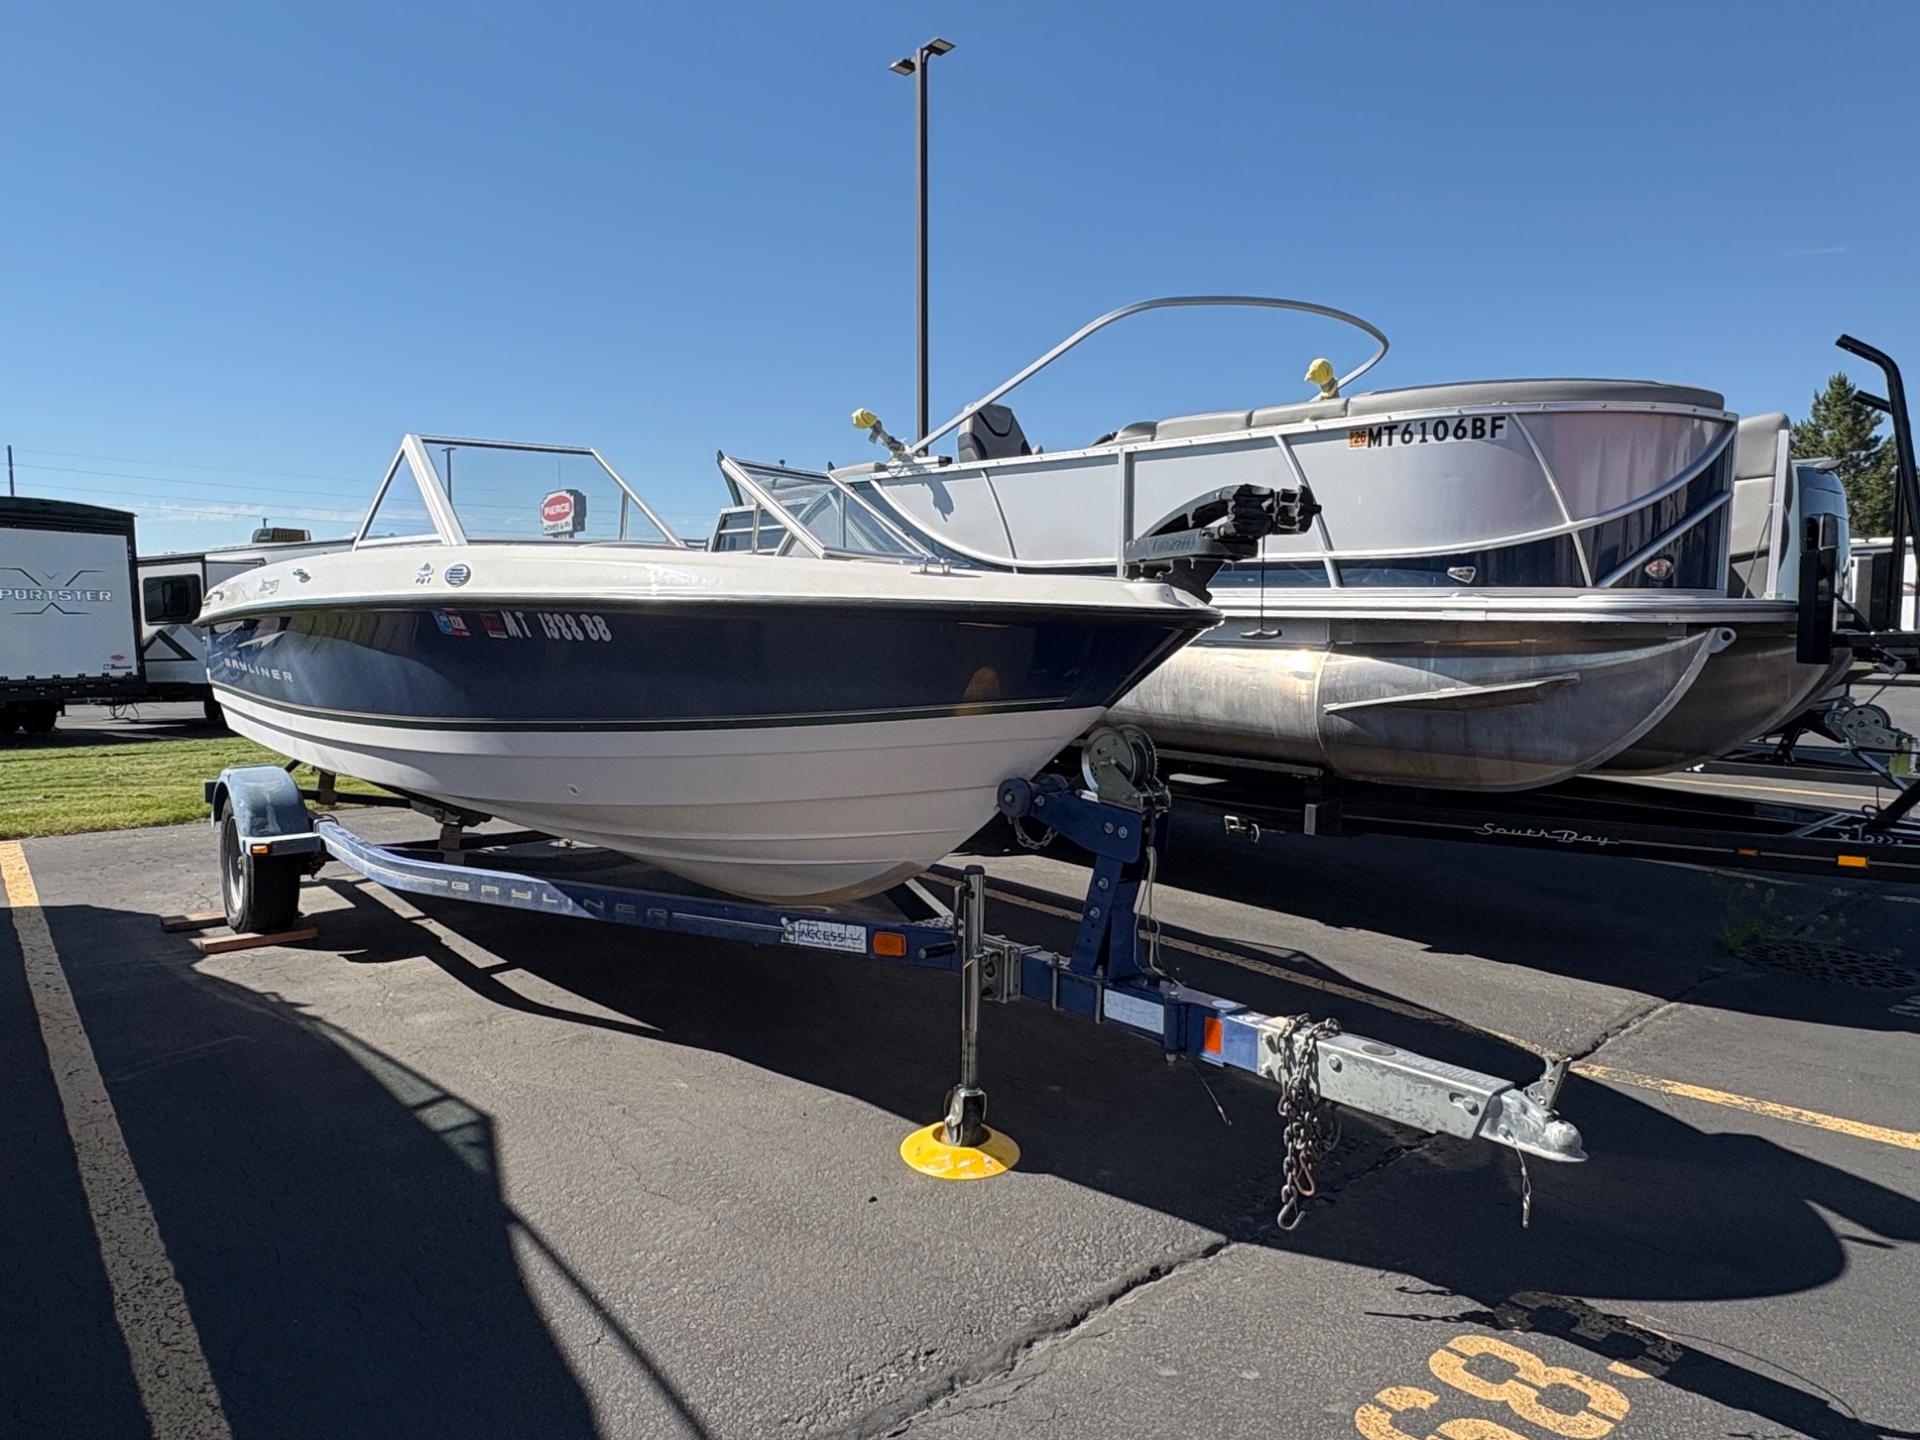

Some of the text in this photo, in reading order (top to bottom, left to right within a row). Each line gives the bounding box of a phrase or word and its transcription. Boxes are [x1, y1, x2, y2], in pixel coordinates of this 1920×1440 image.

[1367, 416, 1506, 448] MT6106BF
[544, 502, 570, 516] PIERCE
[501, 610, 533, 640] MT
[224, 658, 294, 682] BAYLINER
[1474, 823, 1610, 845] South Bay
[451, 880, 668, 920] BAYLINER
